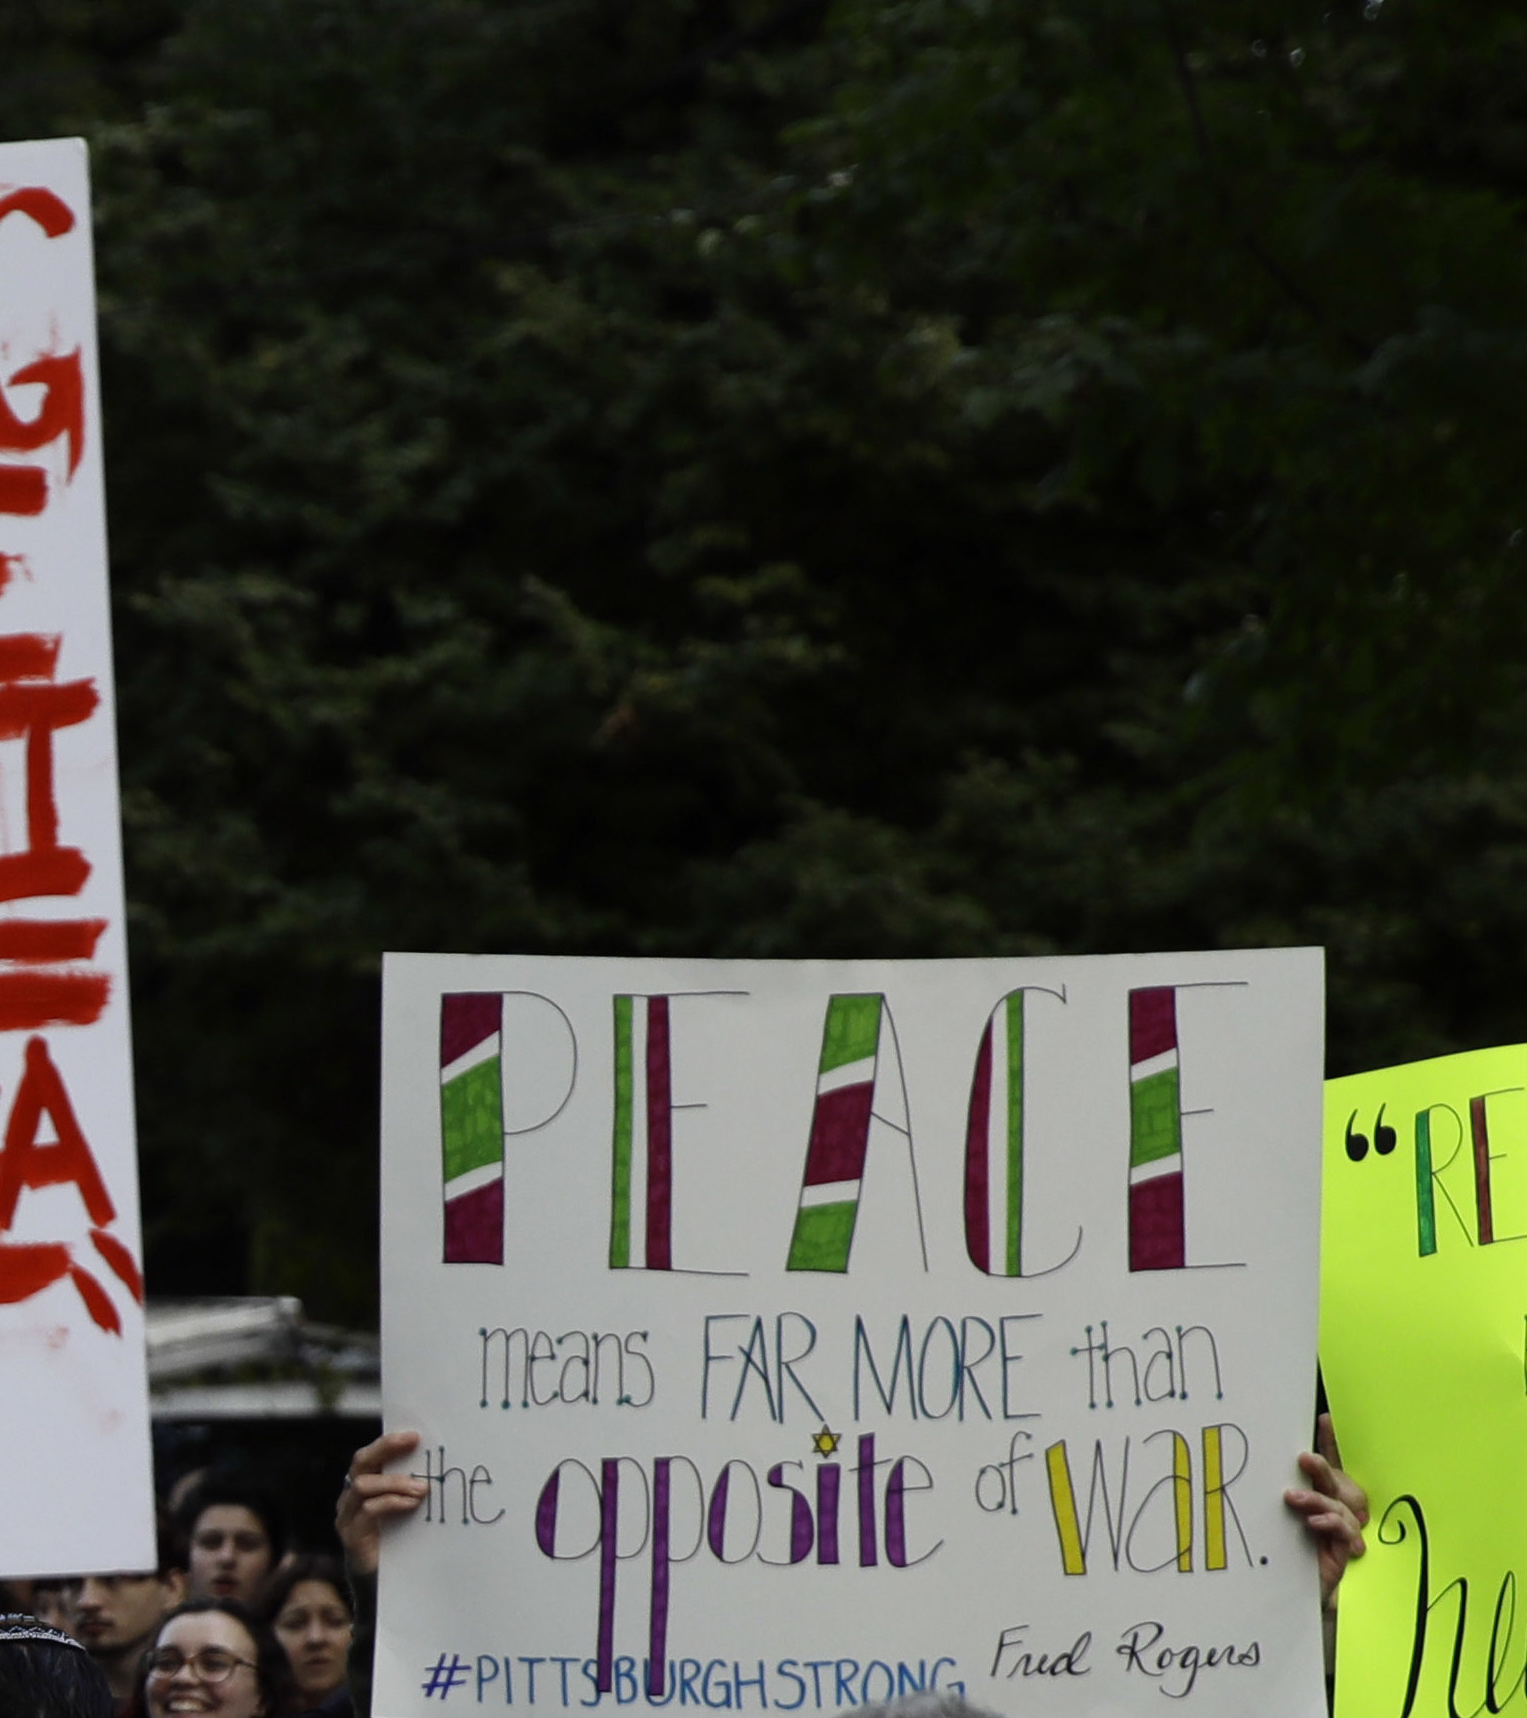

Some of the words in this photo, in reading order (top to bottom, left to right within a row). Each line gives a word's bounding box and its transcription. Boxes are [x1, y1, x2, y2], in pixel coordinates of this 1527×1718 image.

[441, 980, 1248, 1277] PEACE
[478, 1325, 655, 1409] means
[701, 1311, 824, 1422] FAR
[854, 1313, 1043, 1422] MORE
[1071, 1321, 1224, 1408] than
[411, 1445, 506, 1525] the
[535, 1428, 945, 1696] opposite
[976, 1431, 1035, 1514] of
[421, 1651, 967, 1712] #PITTSBURGHSTRONG
[990, 1624, 1091, 1679] Fred
[1115, 1620, 1261, 1698] Rogers
